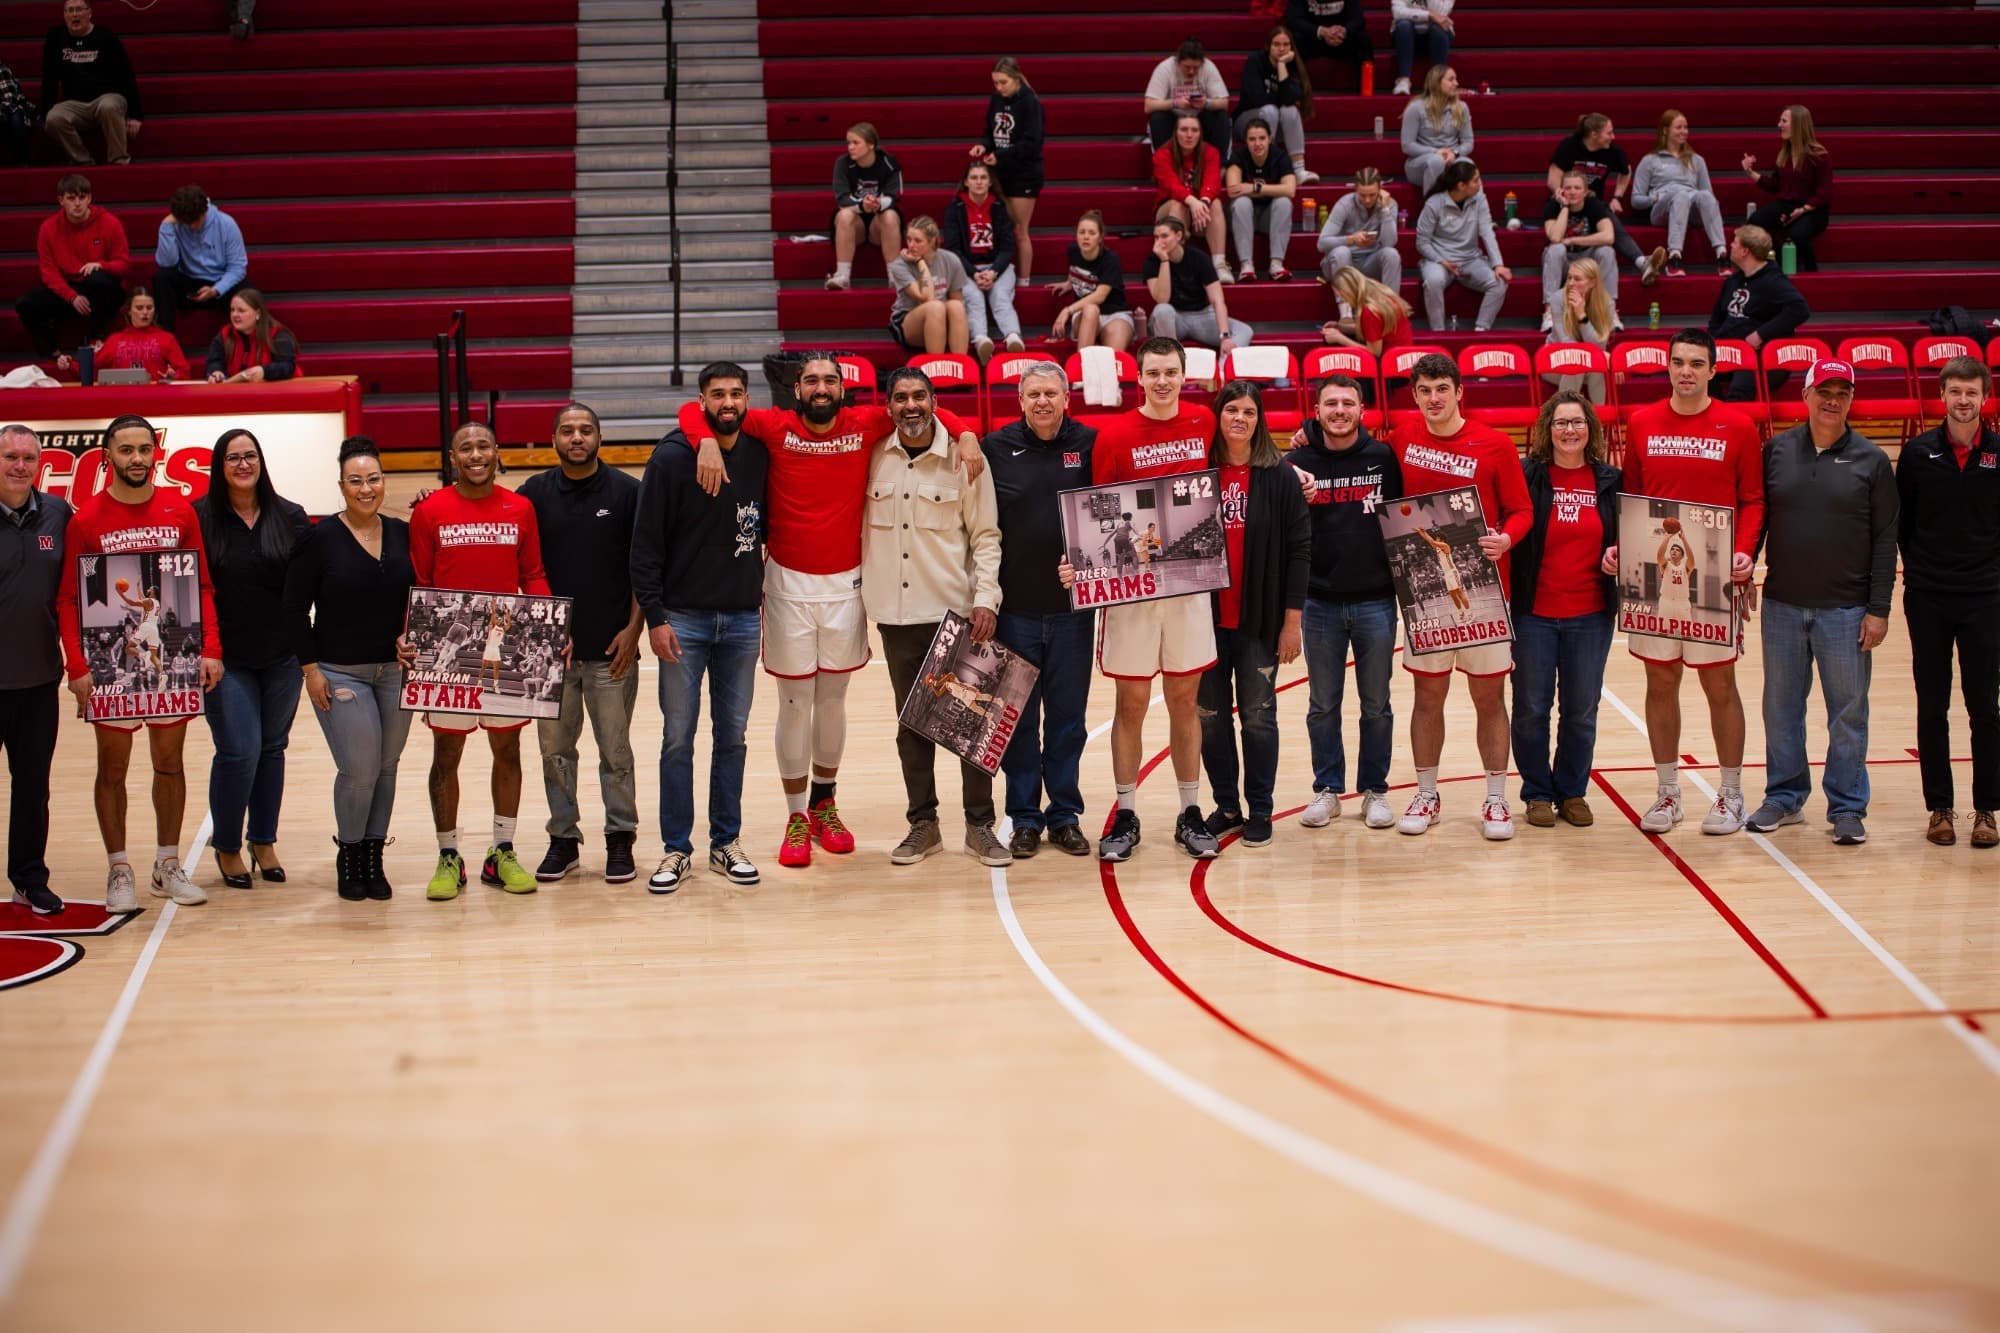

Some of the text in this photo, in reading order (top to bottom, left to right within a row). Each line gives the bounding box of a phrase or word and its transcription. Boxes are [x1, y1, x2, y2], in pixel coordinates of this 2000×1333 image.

[1473, 350, 1515, 371] MONMOUTH
[1549, 349, 1591, 369] MONMOUTH
[1626, 347, 1667, 367] MONMOUTH
[1716, 346, 1742, 365] MOUTH
[1777, 345, 1817, 364] MONMOUTH
[1852, 344, 1892, 364] MONMOUTH
[1928, 343, 1967, 362] MONMOUTH
[1319, 353, 1361, 373] MONMOUTH
[42, 433, 104, 447] IGHTI
[785, 431, 863, 447] MONMOUTH
[1132, 438, 1204, 459] MONMOUTH
[1648, 435, 1727, 450] MONMOUTH
[1135, 453, 1186, 467] BASKETBALL
[1406, 443, 1478, 469] MONMOUTH
[1648, 448, 1699, 456] BASKETBALL
[1405, 456, 1450, 472] BASKETBALL
[1173, 476, 1213, 499] #42
[1352, 474, 1383, 486] COLLEGE
[1449, 491, 1475, 513] #5
[1553, 492, 1598, 504] NMOUTH
[1689, 508, 1728, 530] #30
[99, 526, 180, 547] MONMOUTH
[439, 523, 519, 538] MONMOUTH
[441, 535, 496, 546] BASKETBALL
[39, 536, 53, 550] M
[105, 539, 158, 553] BASKETBALL
[158, 554, 195, 577] #12
[1074, 567, 1108, 581] TYLER
[1075, 572, 1156, 606] HARMS
[530, 601, 567, 625] #14
[1622, 602, 1652, 614] RYAN
[1409, 618, 1441, 632] OSCAR
[1414, 620, 1508, 650] ALCOBENDAS
[1623, 613, 1728, 642] ADOLPHSON
[934, 620, 961, 659] #32
[407, 670, 471, 684] DAMARIAN
[90, 690, 201, 719] WILLIAMS
[406, 682, 485, 711] STARK
[975, 721, 997, 762] YUVRAJ
[982, 704, 1019, 770] SIDHU
